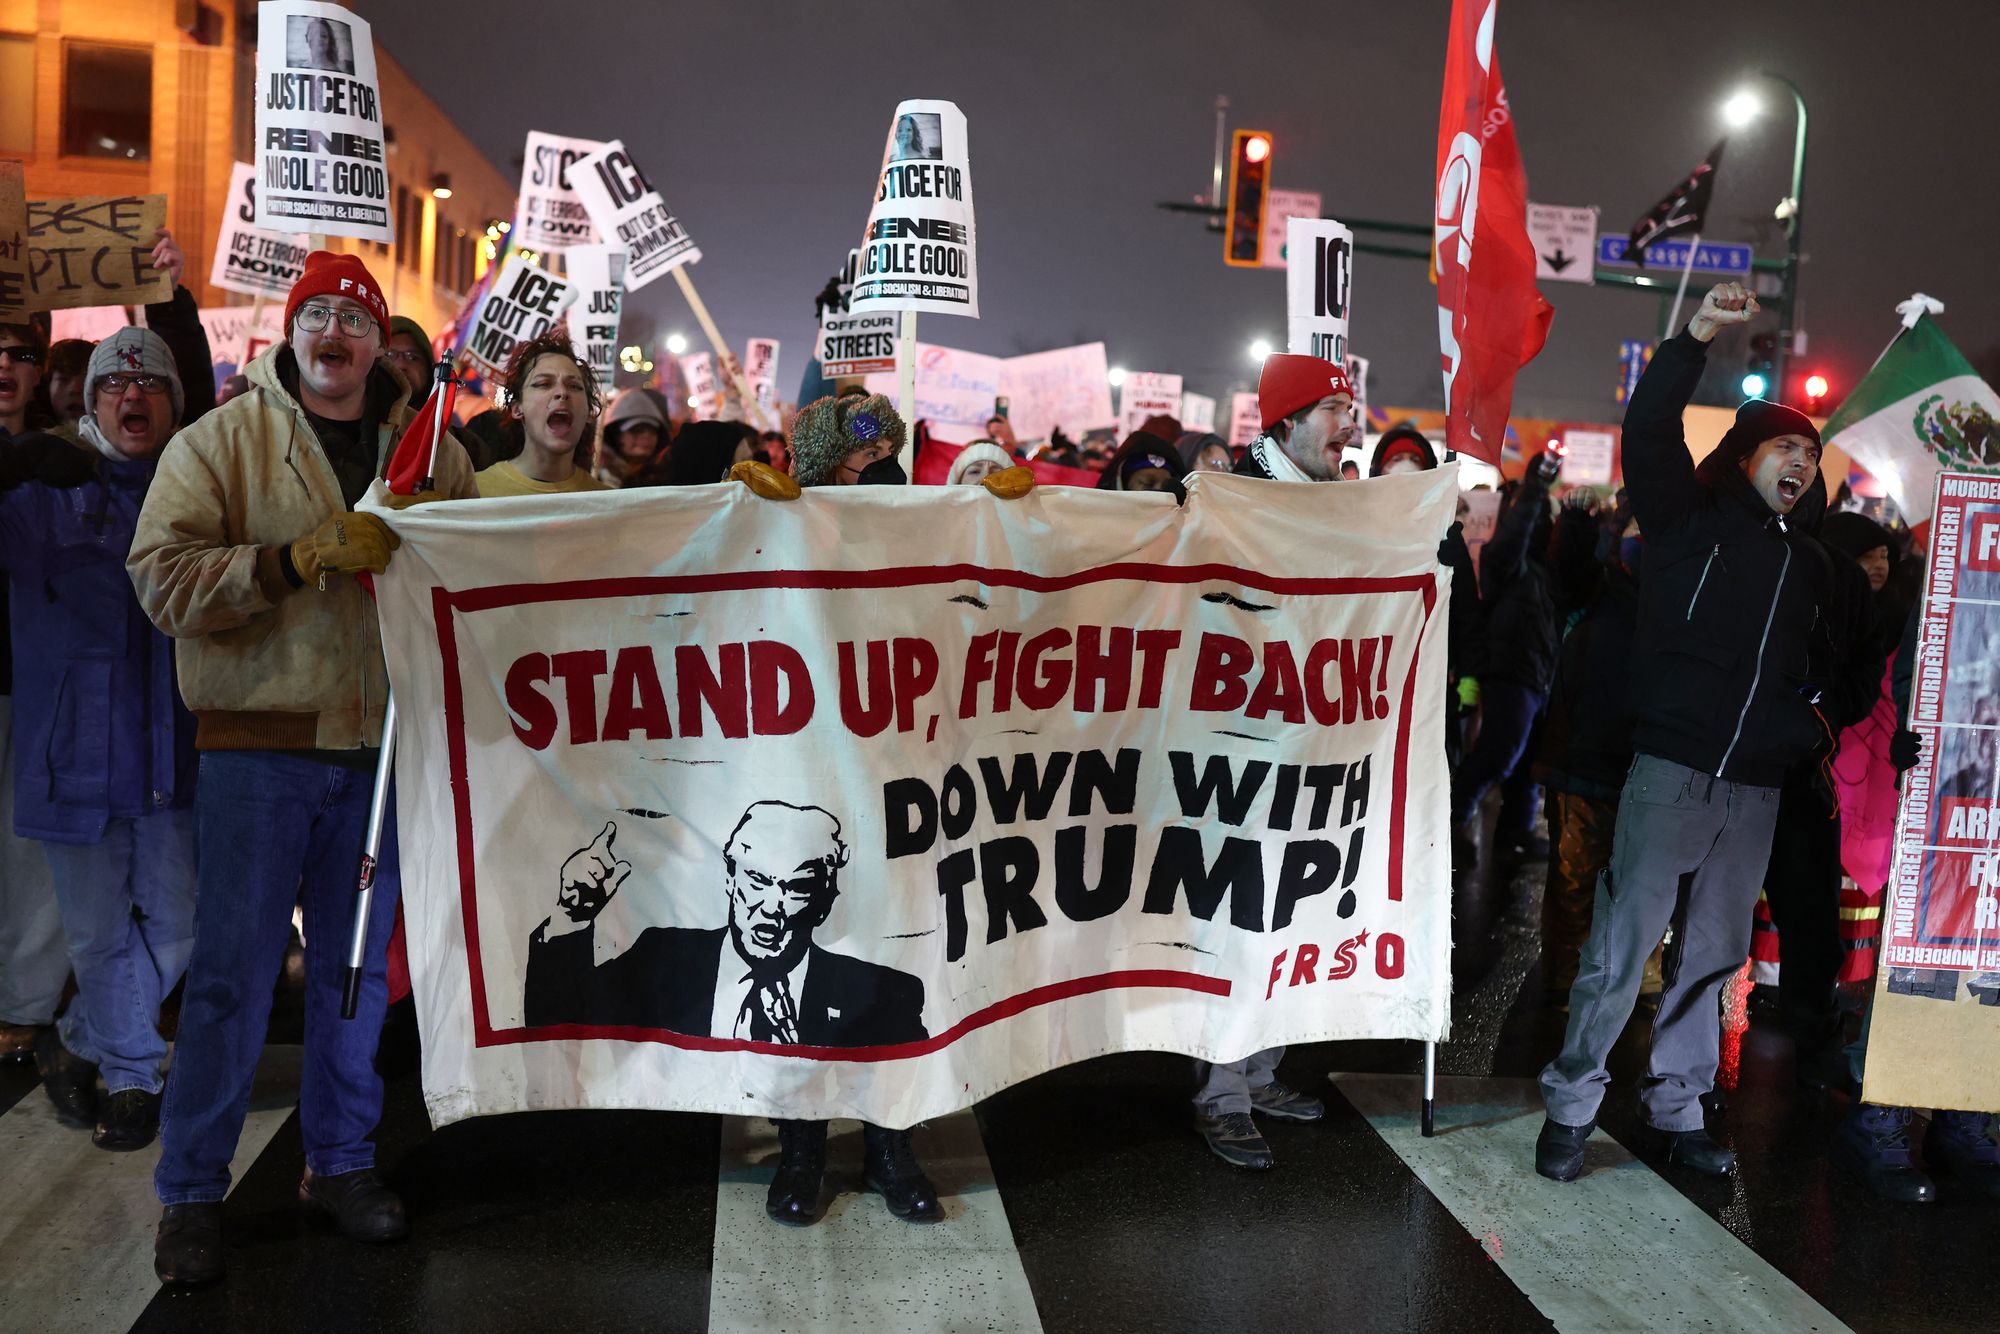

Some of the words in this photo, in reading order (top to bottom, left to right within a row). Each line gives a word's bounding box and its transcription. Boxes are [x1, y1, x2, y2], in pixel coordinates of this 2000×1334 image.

[266, 73, 347, 116] JUSTICE
[349, 80, 378, 123] FOR
[266, 127, 382, 163] RENEE
[266, 155, 328, 193] NICOLE
[333, 161, 385, 200] GOOD
[594, 148, 650, 210] IC
[933, 165, 962, 202] FOR
[293, 201, 336, 218] SOCIALISM
[336, 206, 347, 218] &
[348, 207, 386, 223] LIBERATION
[231, 232, 253, 255] ICE
[919, 244, 968, 279] GOOD
[508, 267, 567, 317] ICE
[868, 284, 883, 296] FOR
[883, 282, 922, 296] SOCIALISM
[922, 284, 932, 297] &
[932, 285, 968, 301] LIBERATION
[483, 296, 531, 336] OUT
[825, 319, 858, 331] OFF
[860, 316, 894, 329] OUR
[472, 320, 516, 365] MP
[824, 332, 894, 361] STREETS
[1942, 478, 2000, 501] MURDE
[335, 519, 347, 546] KINCO
[1930, 505, 1962, 614] MURDERER!
[1918, 616, 1949, 721] MURDERER!
[503, 639, 816, 752] STAND
[836, 636, 940, 744] UP,
[958, 625, 1183, 720] FIGHT
[1188, 631, 1395, 727] BACK!
[882, 747, 1142, 860] DOWN
[1167, 750, 1372, 832] WITH
[936, 823, 1366, 963] TRUMP!
[1889, 945, 1976, 967] MURDERER!
